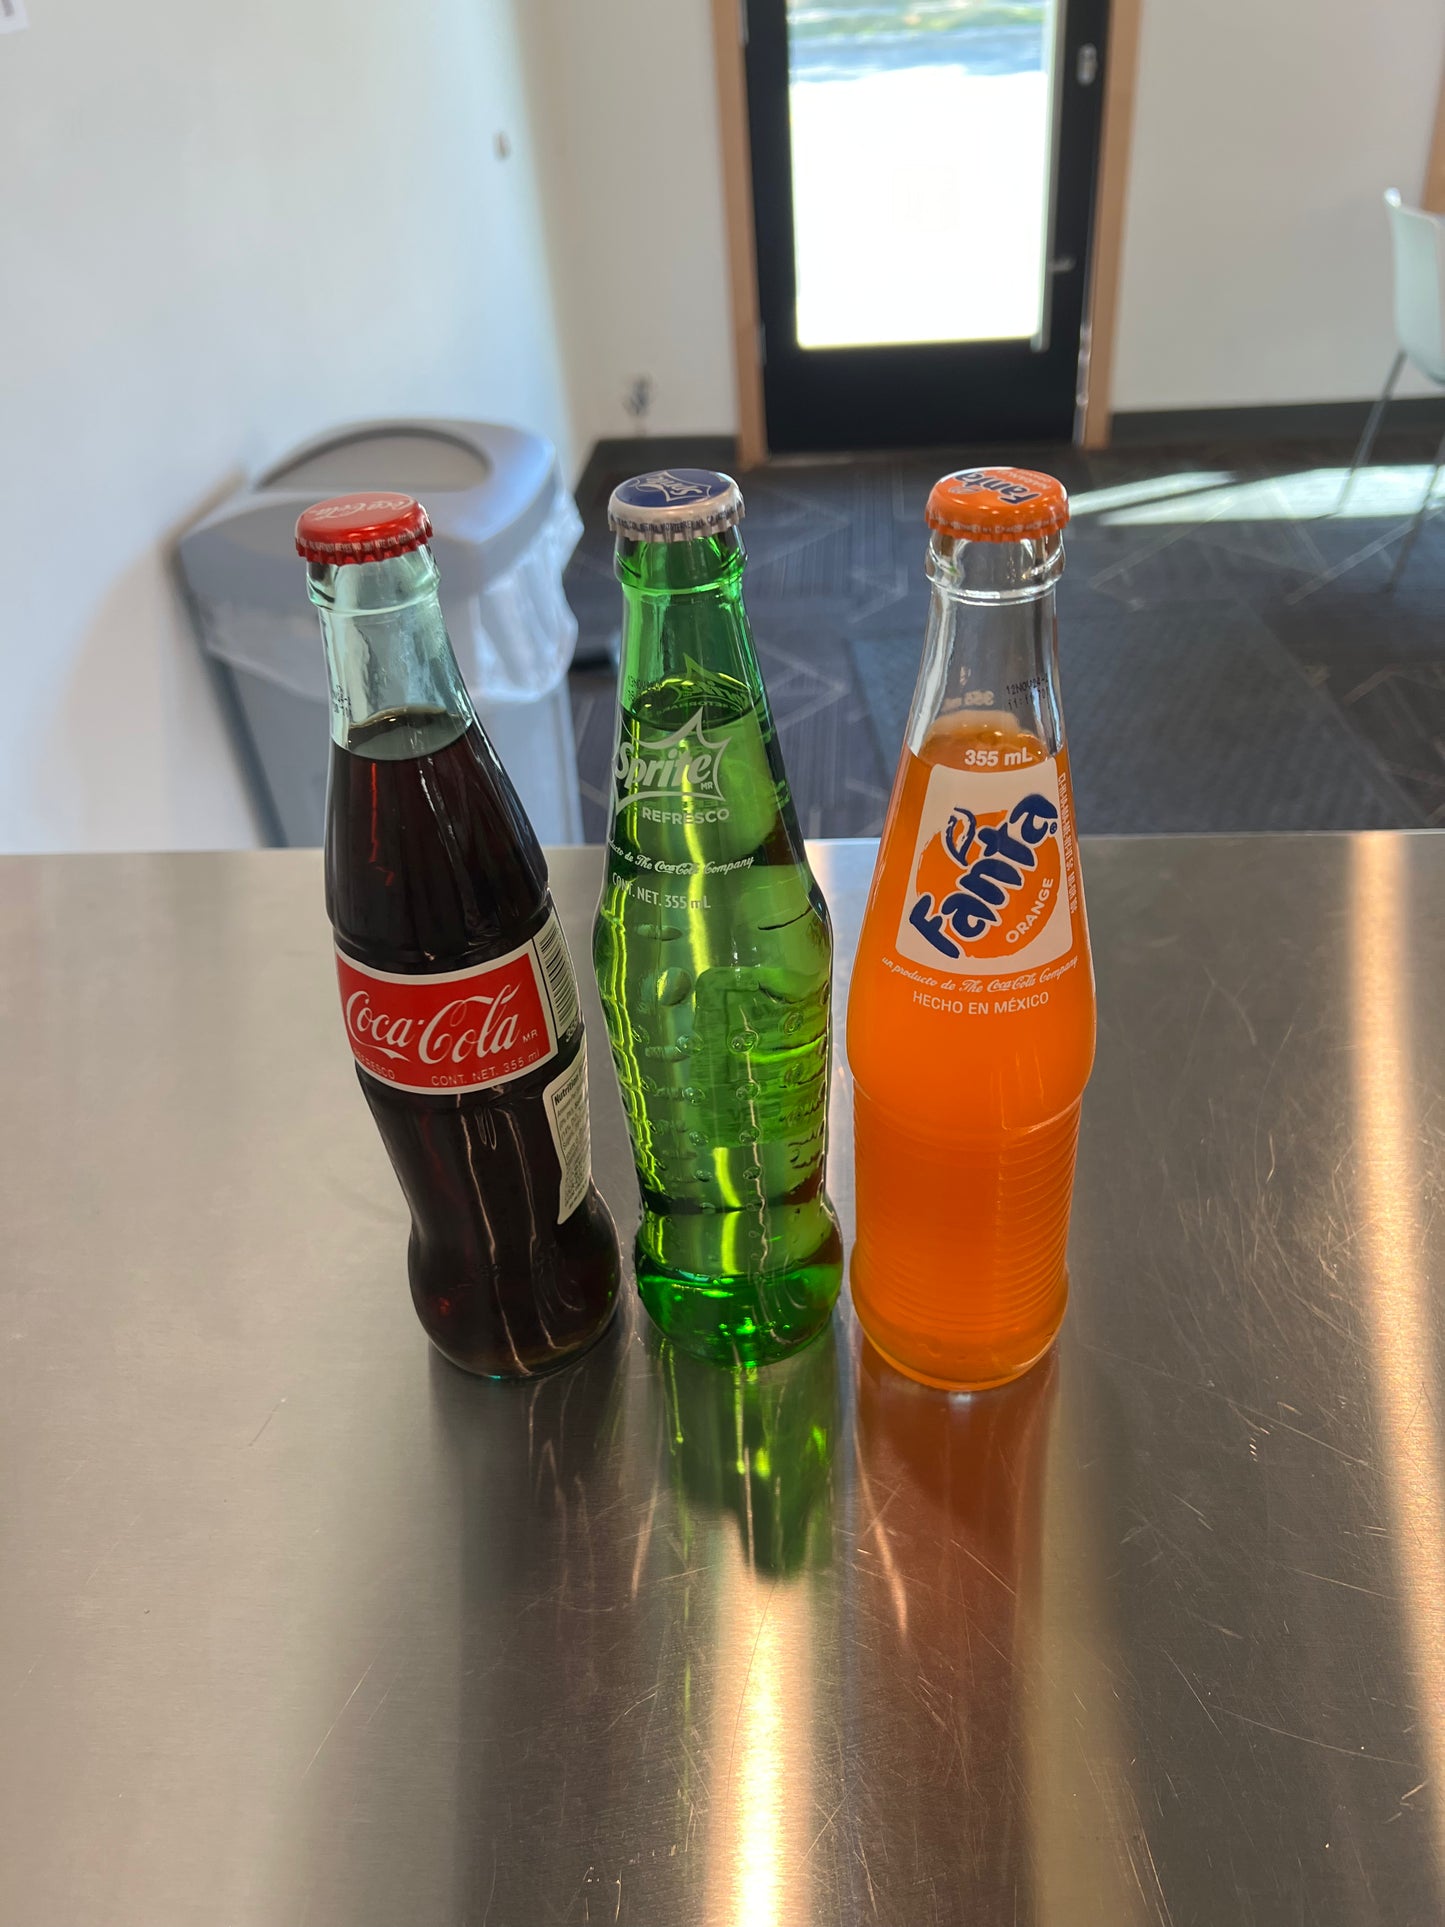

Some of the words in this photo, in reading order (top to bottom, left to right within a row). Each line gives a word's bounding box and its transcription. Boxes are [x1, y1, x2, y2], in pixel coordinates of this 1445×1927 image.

[955, 471, 1040, 505] Fanta
[614, 741, 711, 790] Sprite
[964, 749, 999, 767] 355
[1004, 747, 1033, 766] mL
[700, 781, 713, 790] MR
[641, 806, 730, 825] REFRESCO
[624, 851, 634, 863] de
[635, 854, 653, 870] The
[704, 856, 754, 875] Company
[909, 793, 1058, 959] Fanta
[612, 872, 636, 897] CONT.
[637, 886, 662, 906] NET.
[664, 894, 687, 909] 355
[1005, 877, 1054, 944] ORANGE
[882, 956, 894, 969] un
[892, 964, 938, 987] producto
[941, 980, 956, 991] de
[959, 979, 984, 993] The
[1039, 955, 1079, 984] Company
[912, 990, 964, 1015] HECHO
[968, 1001, 989, 1016] EN
[993, 991, 1050, 1014] MÉXICO
[346, 983, 521, 1066] Coca-Cola
[522, 1029, 539, 1043] MR
[431, 1074, 468, 1087] CONT.
[472, 1065, 499, 1082] NET.
[503, 1055, 526, 1073] 355
